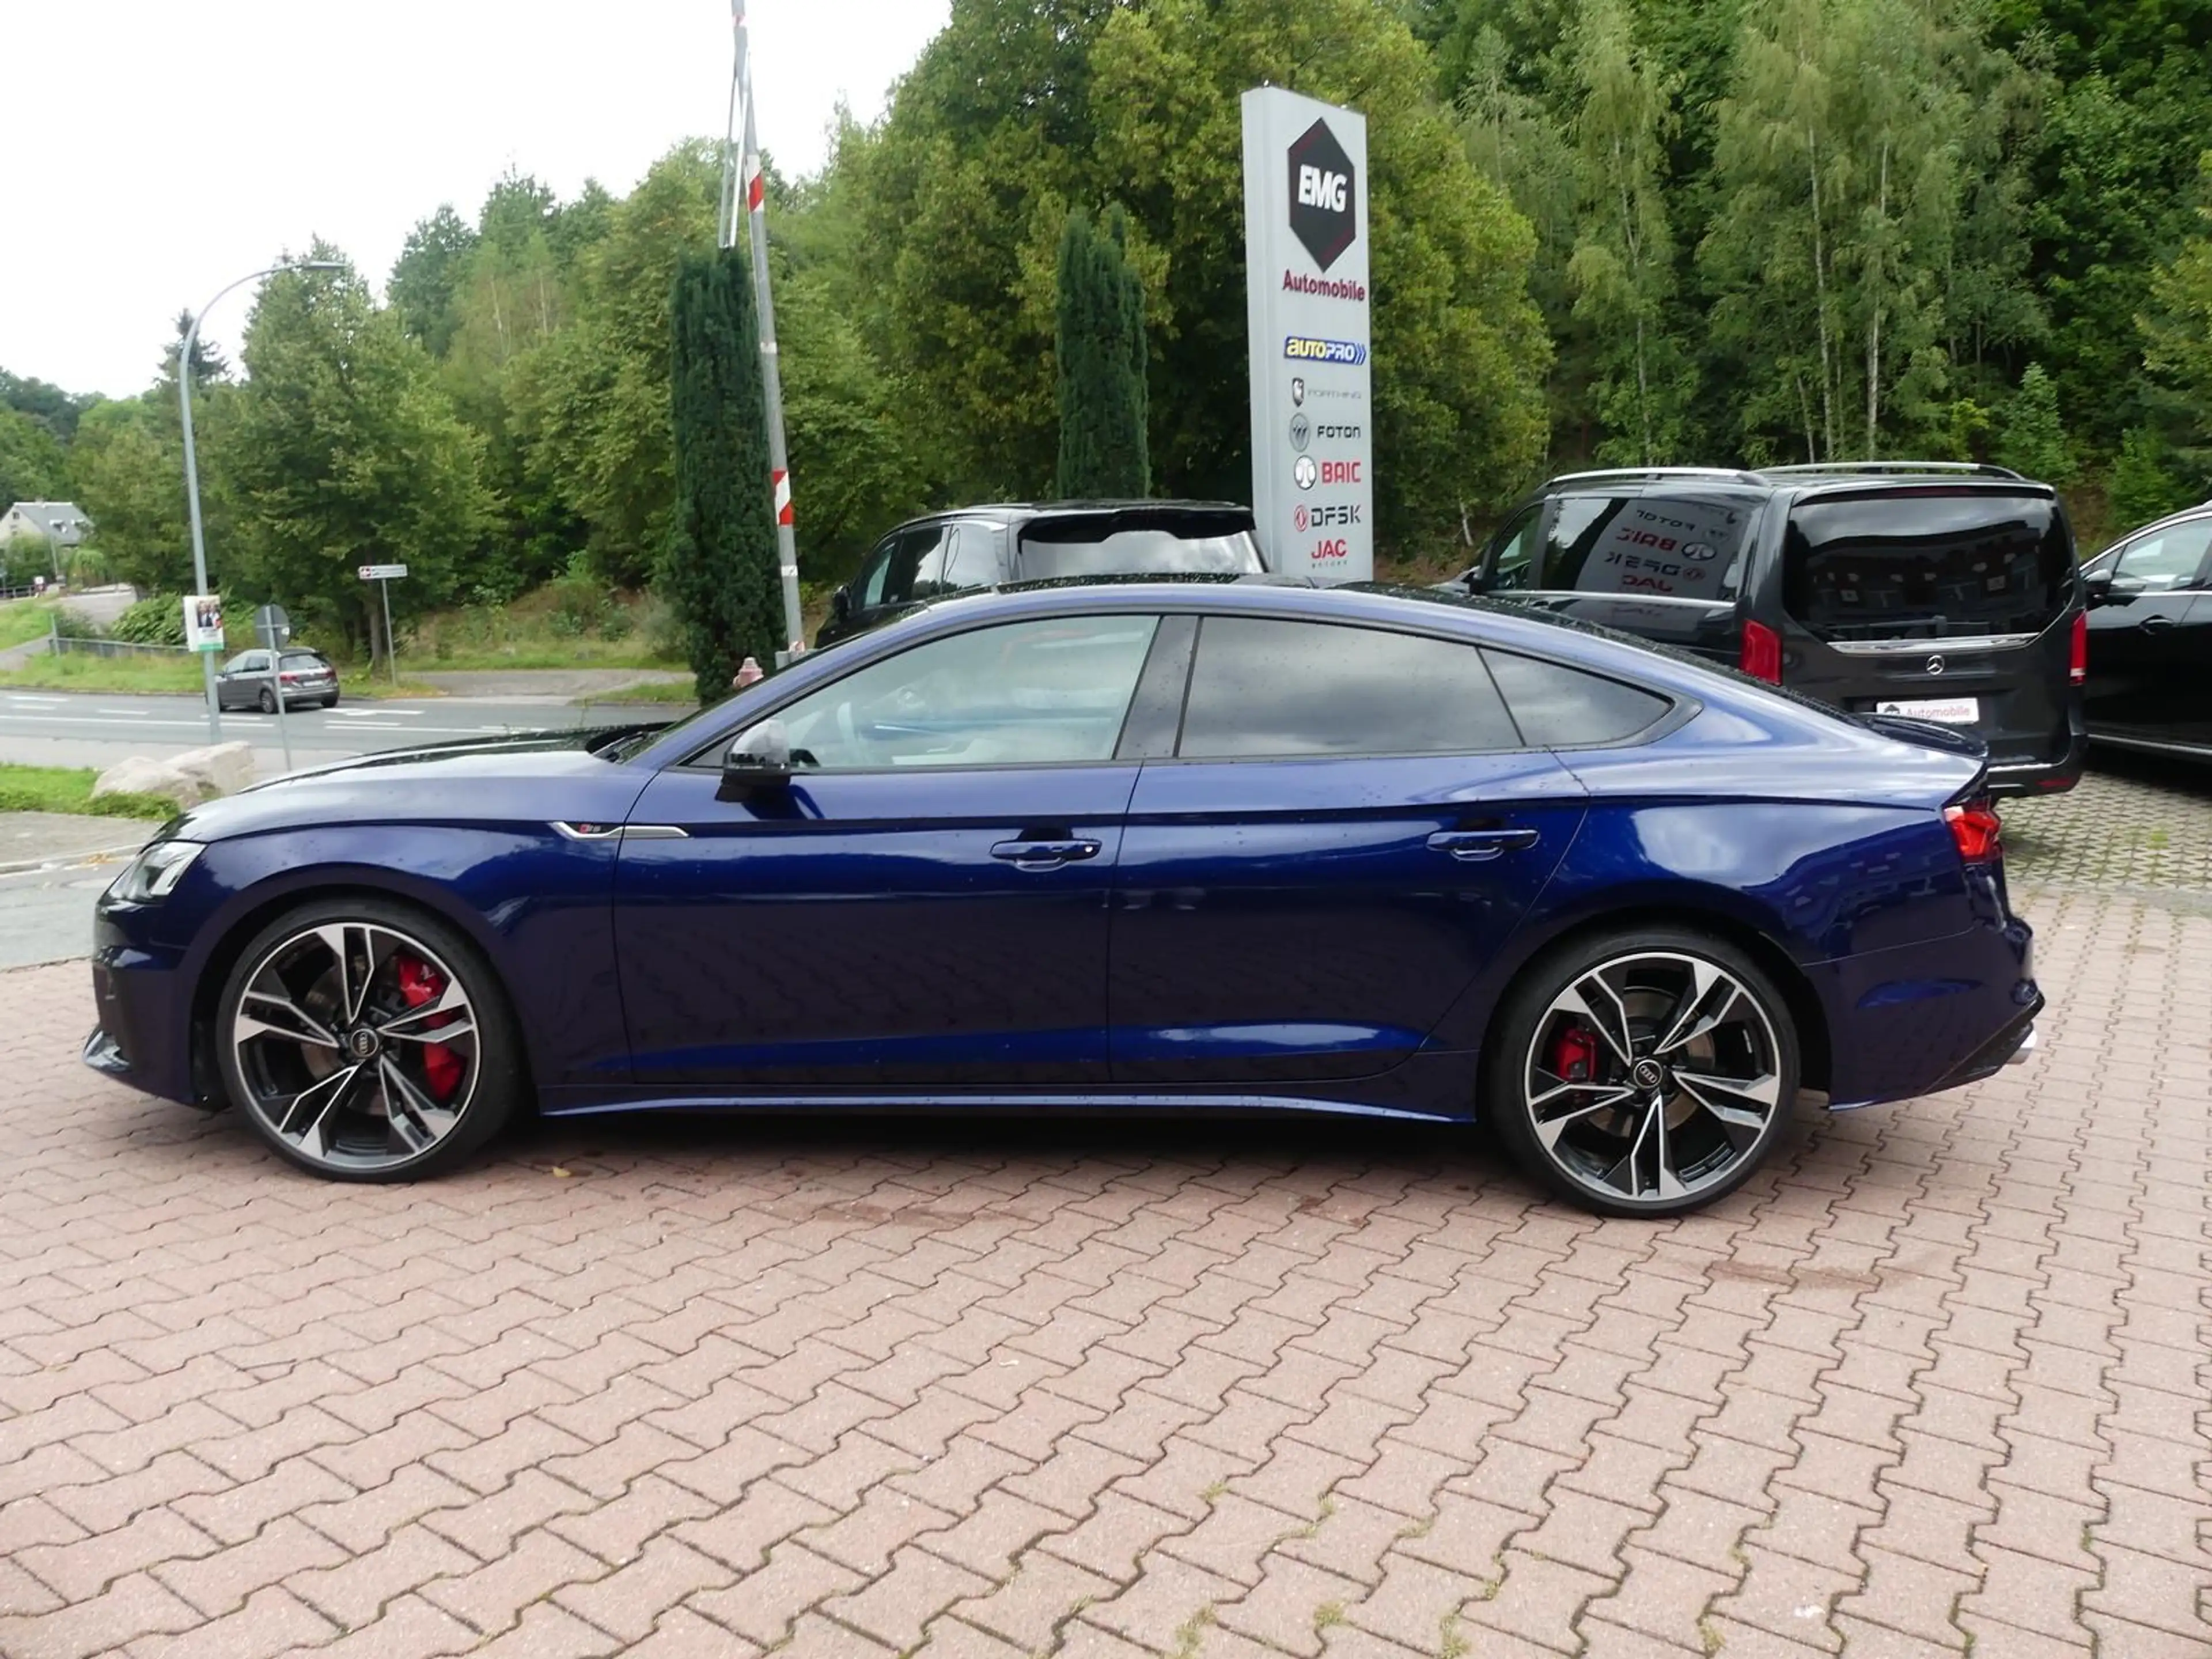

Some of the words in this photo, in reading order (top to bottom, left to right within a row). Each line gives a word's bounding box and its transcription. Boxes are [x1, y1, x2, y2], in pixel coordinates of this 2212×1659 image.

[1298, 164, 1347, 213] EMG
[1282, 269, 1365, 302] Automobile
[1321, 461, 1362, 484] BAIC
[1310, 504, 1361, 527] DFSK
[1311, 539, 1347, 560] JAC
[1906, 705, 1970, 718] Automobile
